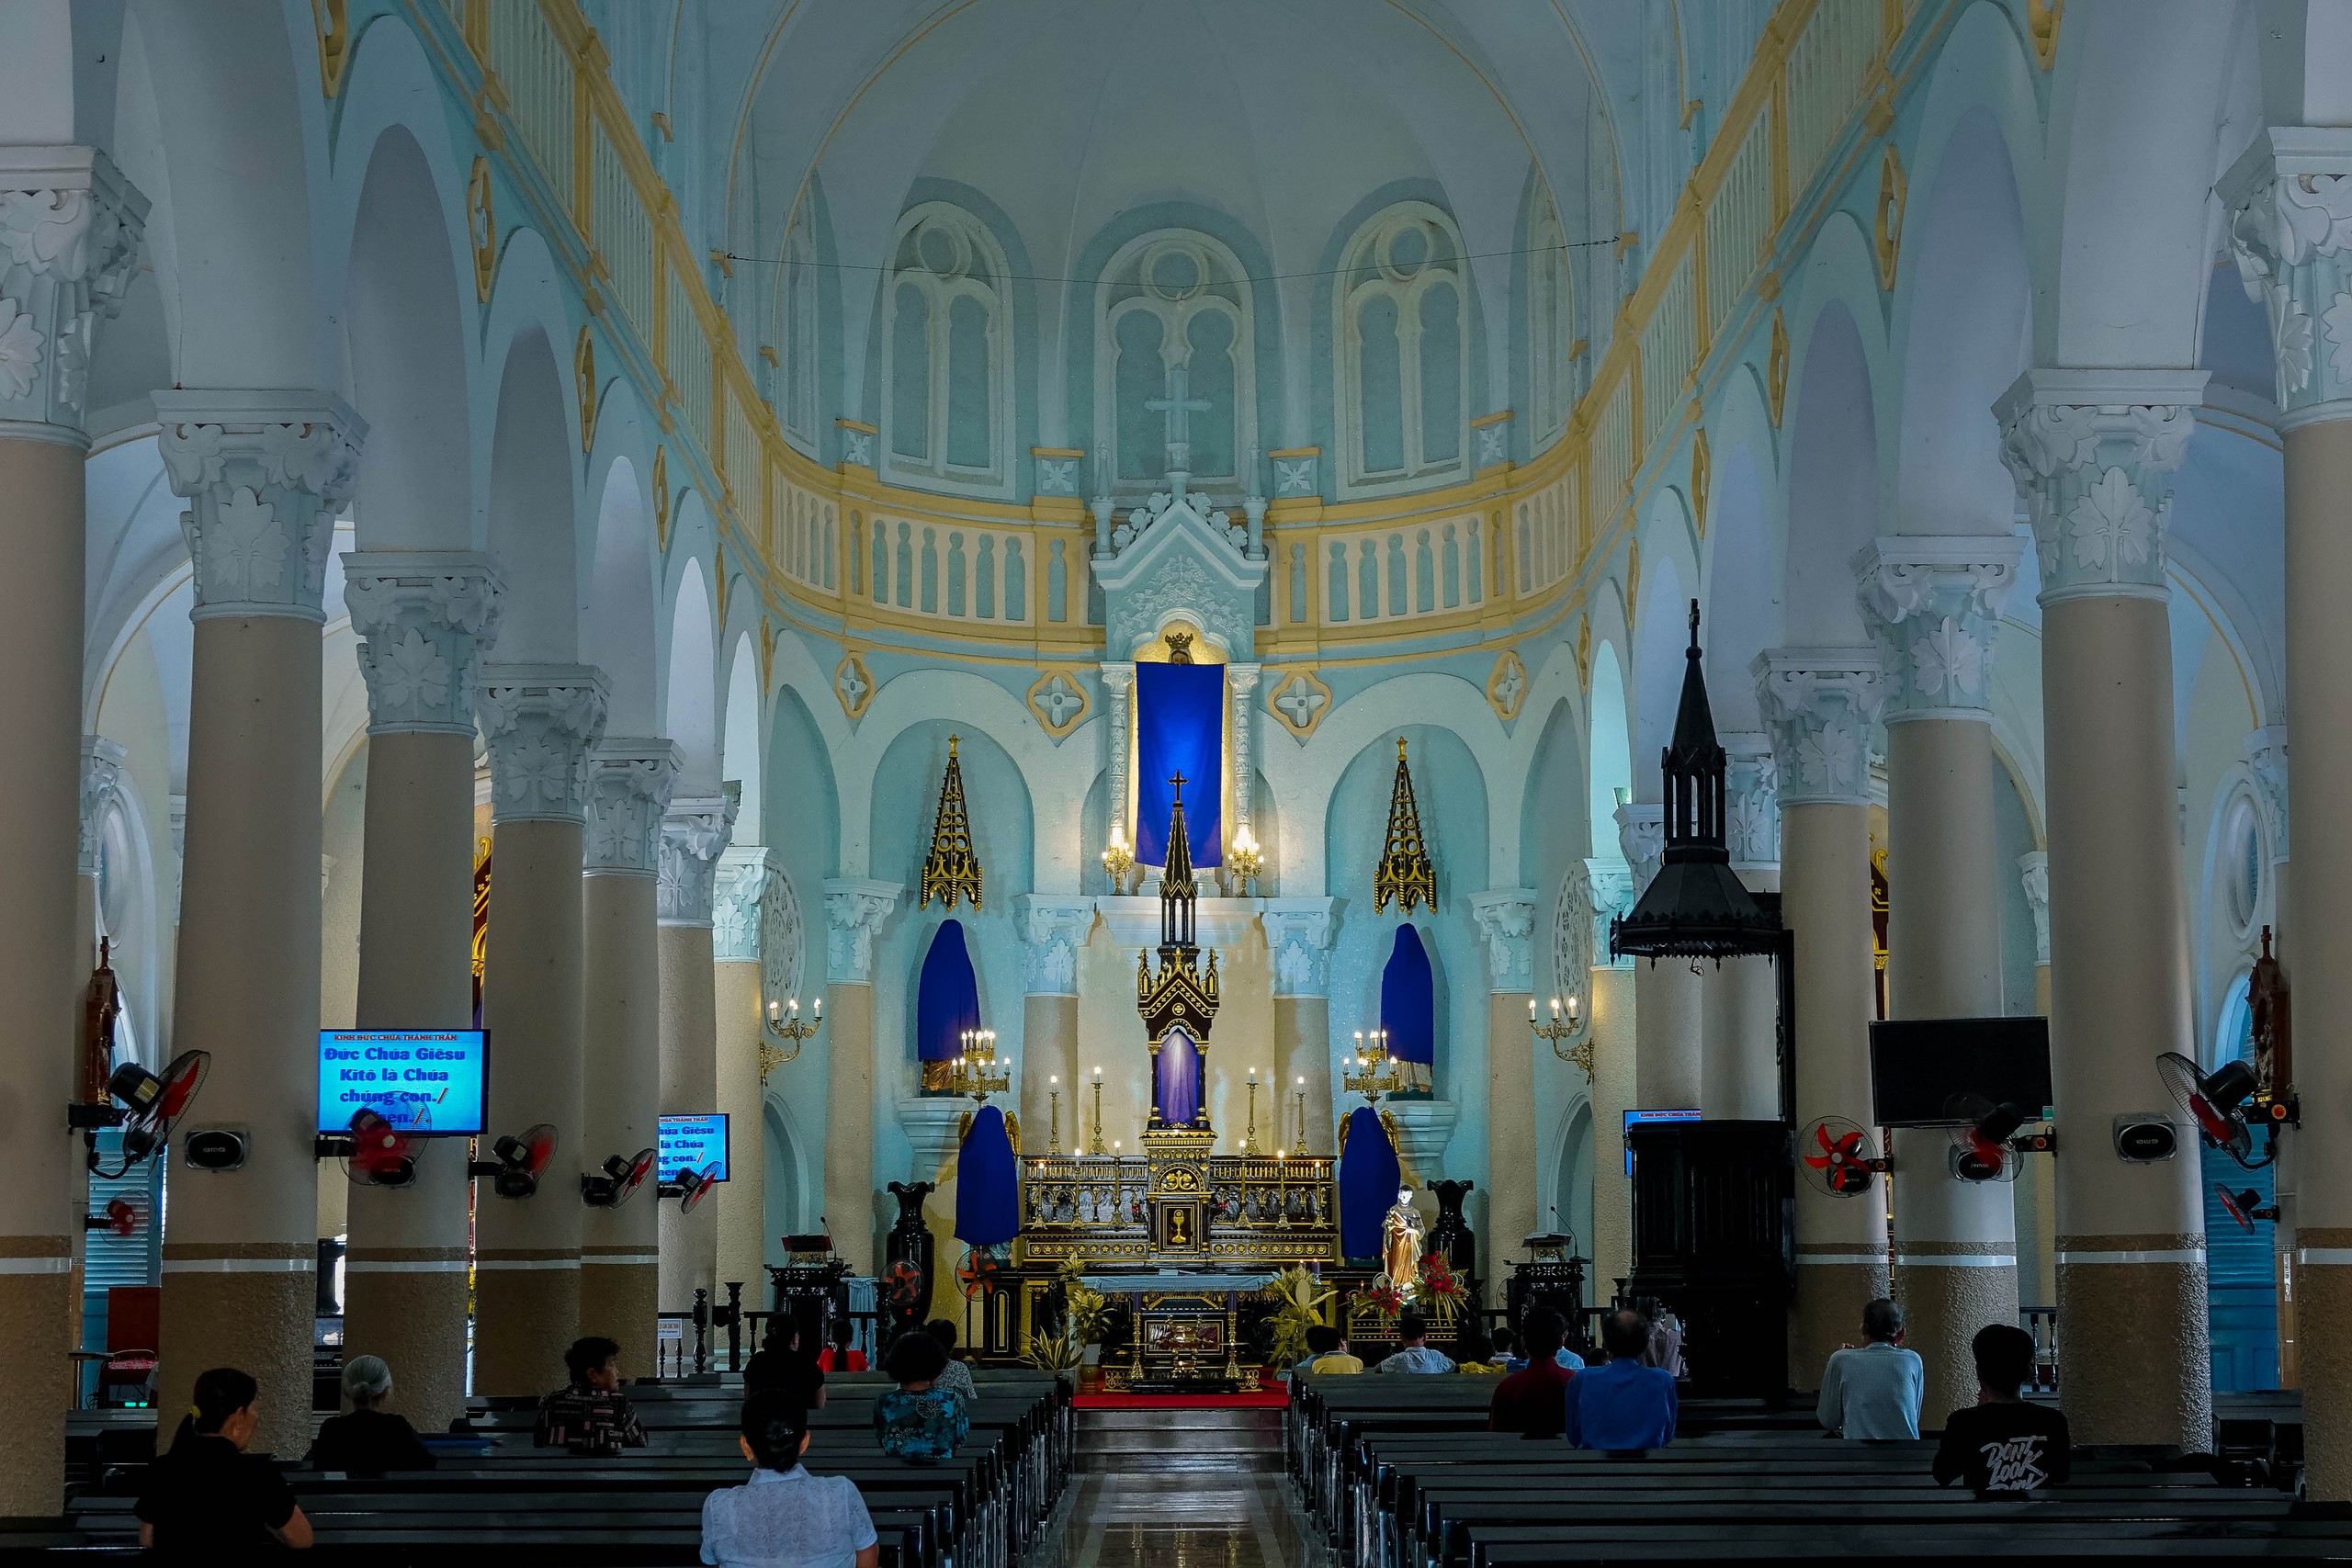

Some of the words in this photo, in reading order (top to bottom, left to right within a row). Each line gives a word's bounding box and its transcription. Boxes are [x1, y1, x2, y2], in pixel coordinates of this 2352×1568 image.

[324, 1047, 360, 1060] Đức
[365, 1047, 410, 1060] Chúa
[415, 1047, 466, 1060] Giêsu
[340, 1068, 376, 1081] Kitô
[382, 1067, 398, 1081] là
[403, 1067, 448, 1081] Chúa
[340, 1089, 395, 1106] chúng
[674, 1139, 704, 1148] Chúa
